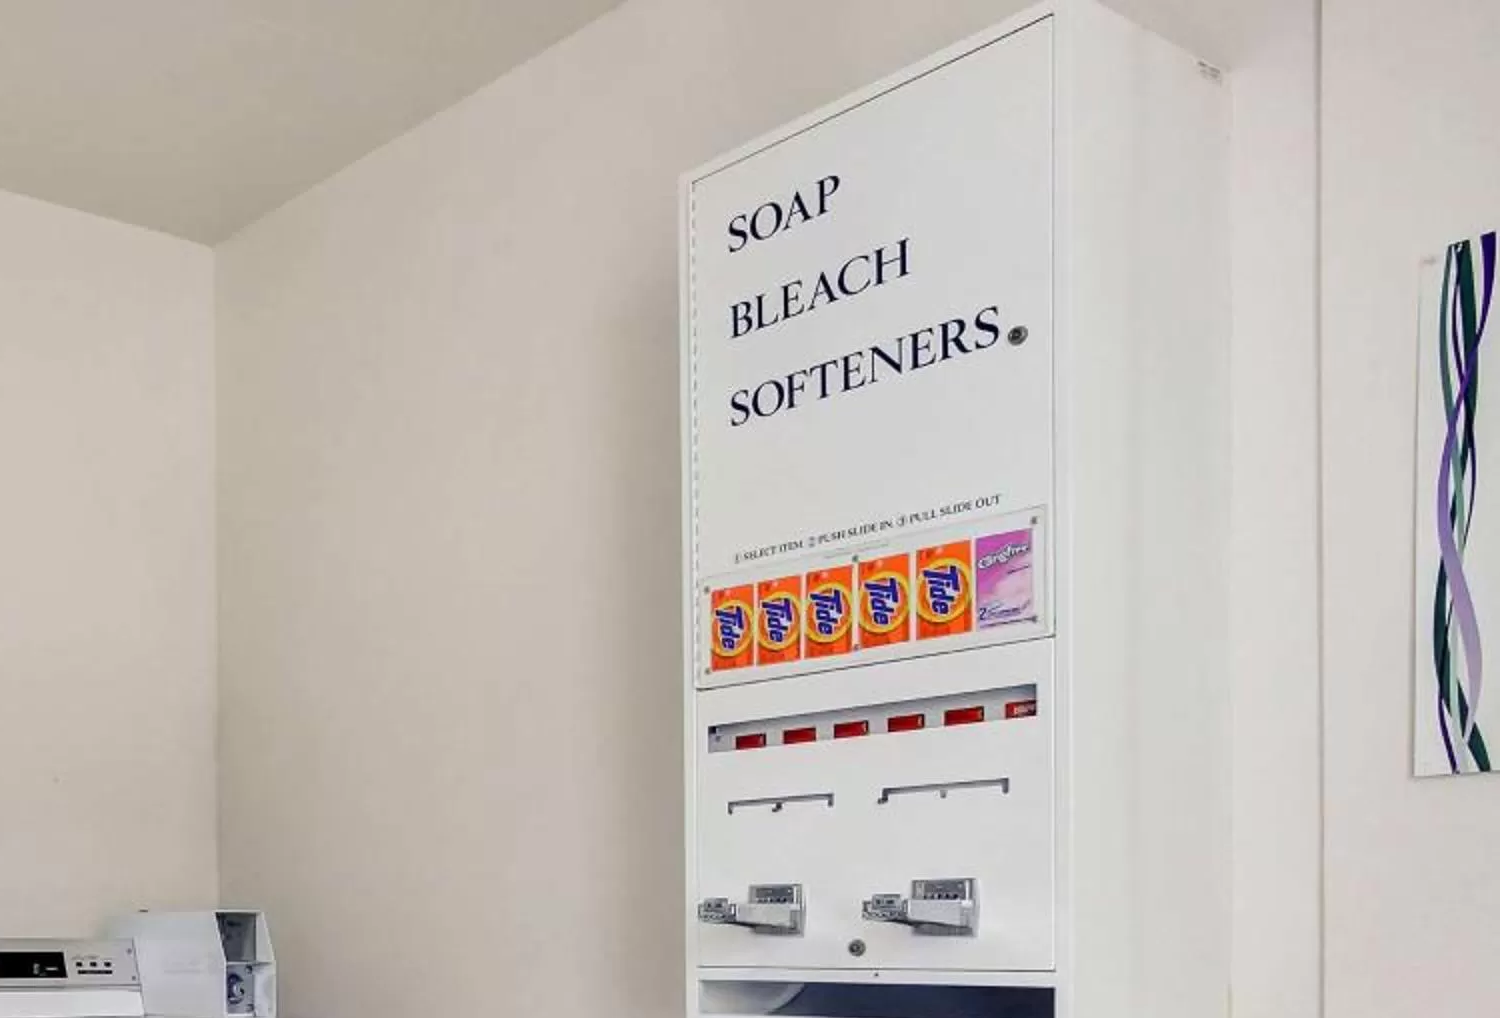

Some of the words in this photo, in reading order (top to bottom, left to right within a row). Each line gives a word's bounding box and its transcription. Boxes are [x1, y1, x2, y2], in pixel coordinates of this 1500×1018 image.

[727, 174, 841, 253] SOAP
[729, 236, 910, 339] BLEACH
[729, 305, 1001, 427] SOFTENERS
[847, 522, 877, 537] SLIDE
[939, 500, 972, 517] SLIDE
[975, 493, 1002, 508] OUT
[810, 588, 844, 636] Tide
[864, 576, 899, 626] Tide
[921, 565, 960, 615] Tide
[715, 605, 745, 650] Tide
[761, 597, 793, 643] Tide
